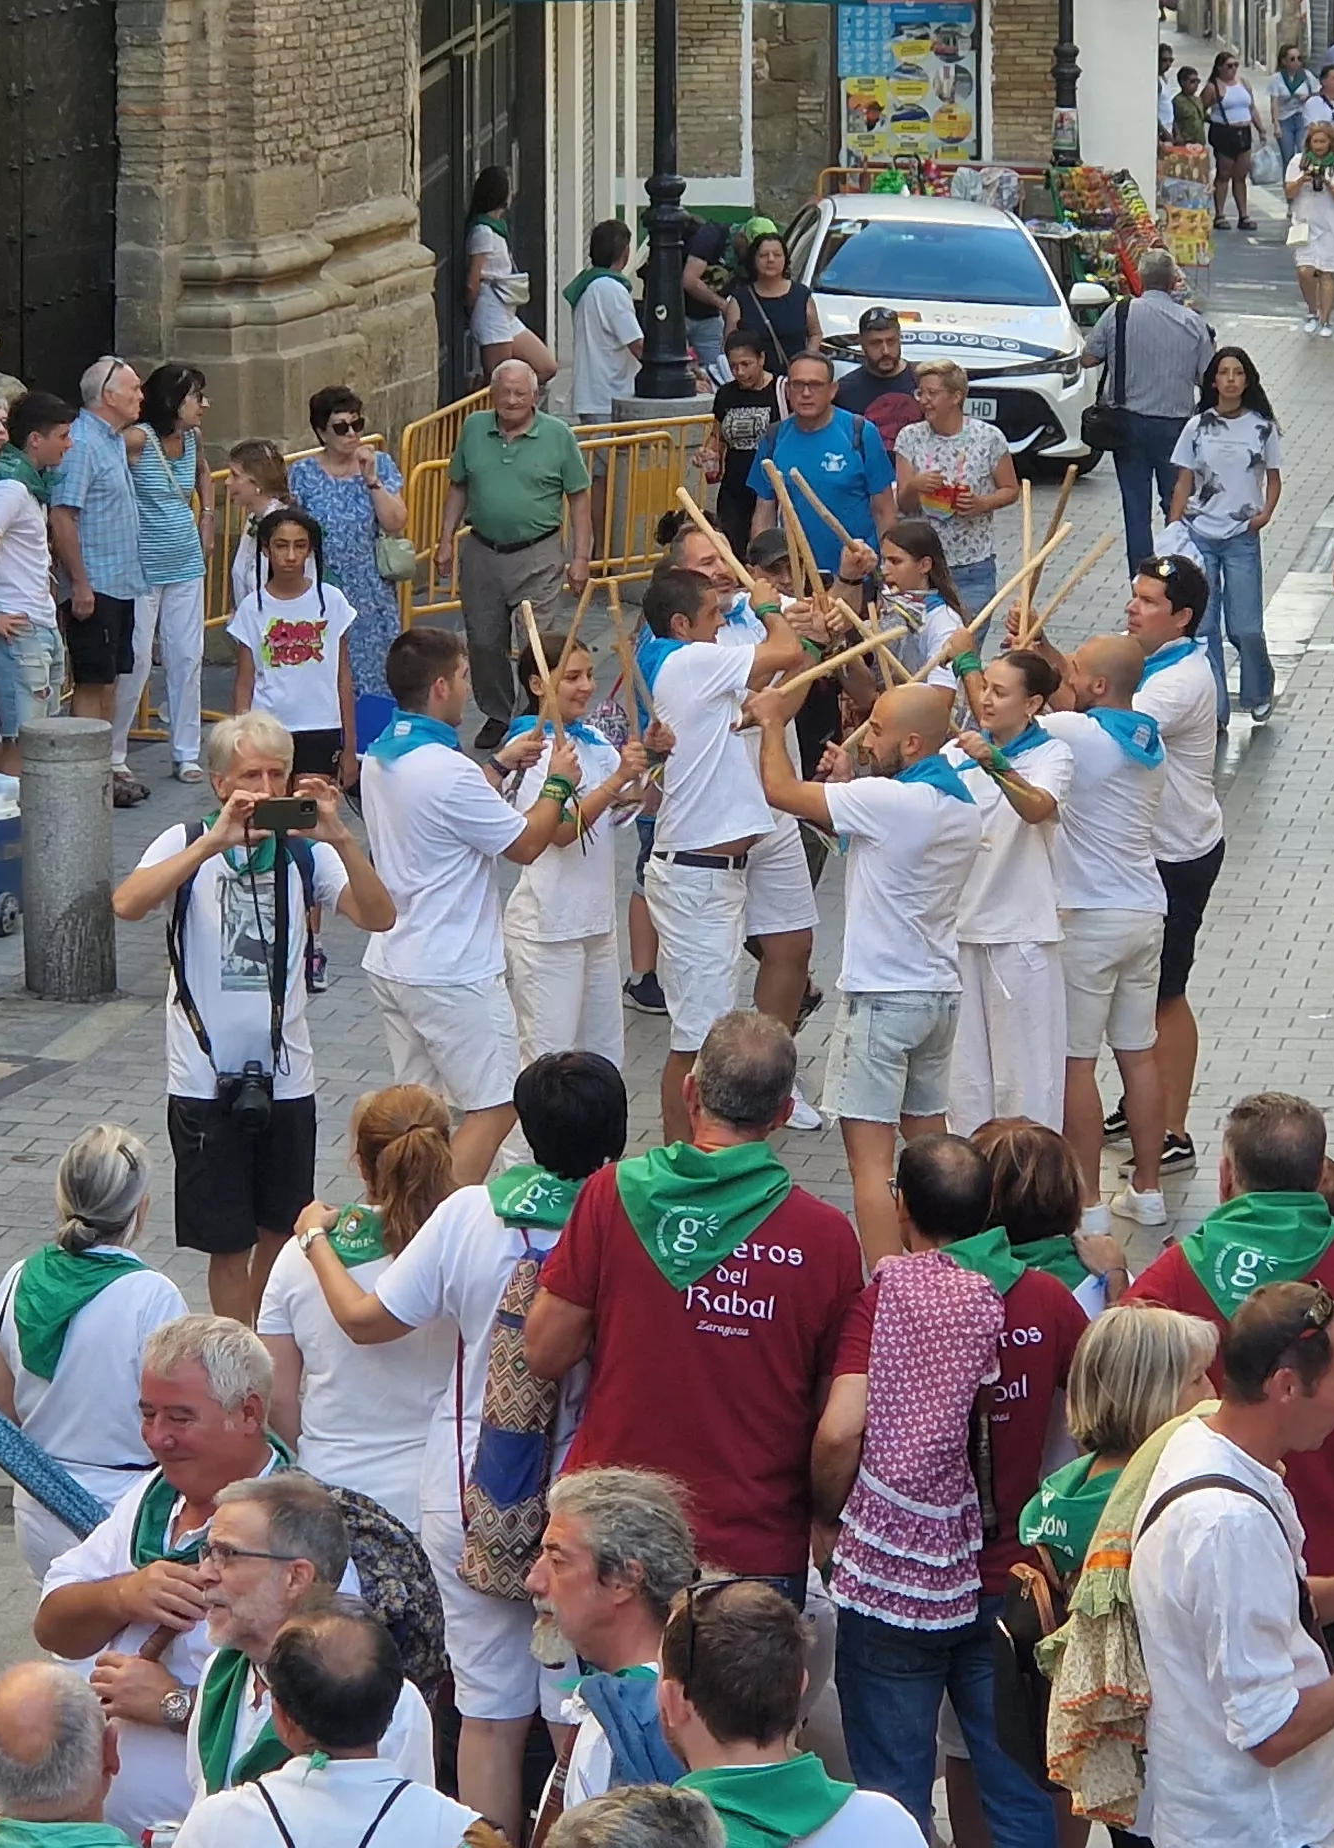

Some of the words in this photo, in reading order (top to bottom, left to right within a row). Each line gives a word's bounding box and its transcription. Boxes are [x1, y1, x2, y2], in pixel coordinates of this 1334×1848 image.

[732, 1241, 803, 1266] eros
[716, 1264, 747, 1286] del
[686, 1284, 775, 1320] Rabal
[696, 1320, 750, 1337] Zaragoza
